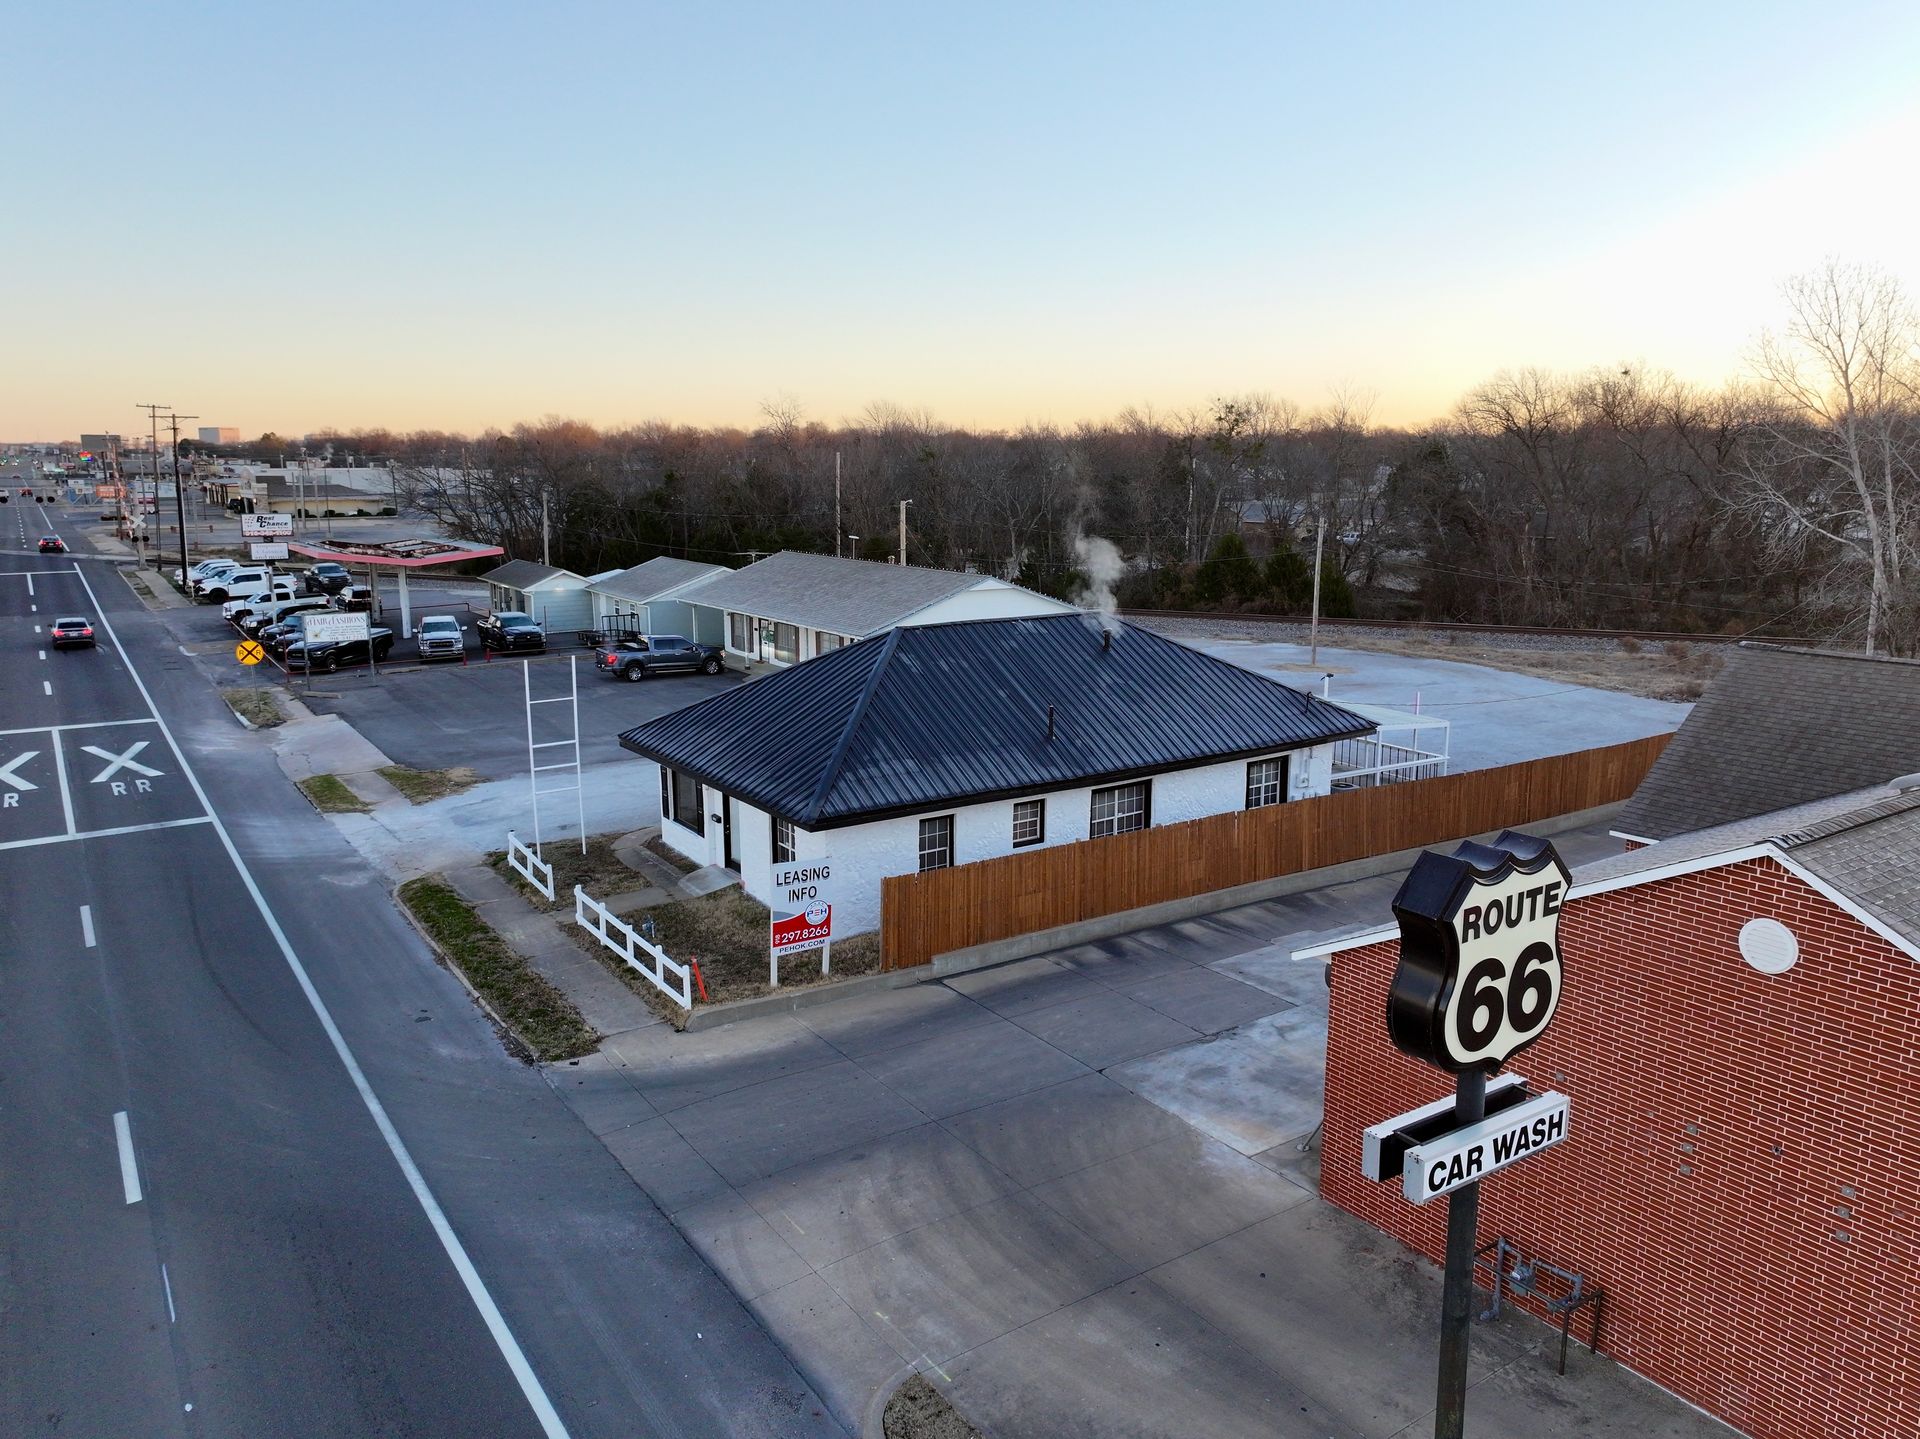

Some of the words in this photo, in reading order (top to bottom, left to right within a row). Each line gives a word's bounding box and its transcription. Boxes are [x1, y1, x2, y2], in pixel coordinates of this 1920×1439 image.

[3, 792, 19, 808] R
[776, 866, 830, 886] LEASING
[788, 886, 817, 902] INFO
[806, 908, 827, 918] PEH
[1461, 880, 1562, 944] ROUTE
[781, 926, 829, 943] 297.8266
[779, 939, 826, 953] PEHOK.COM
[1456, 941, 1554, 1053] 66
[1427, 1145, 1483, 1193] CAR
[1492, 1110, 1564, 1164] WASH
